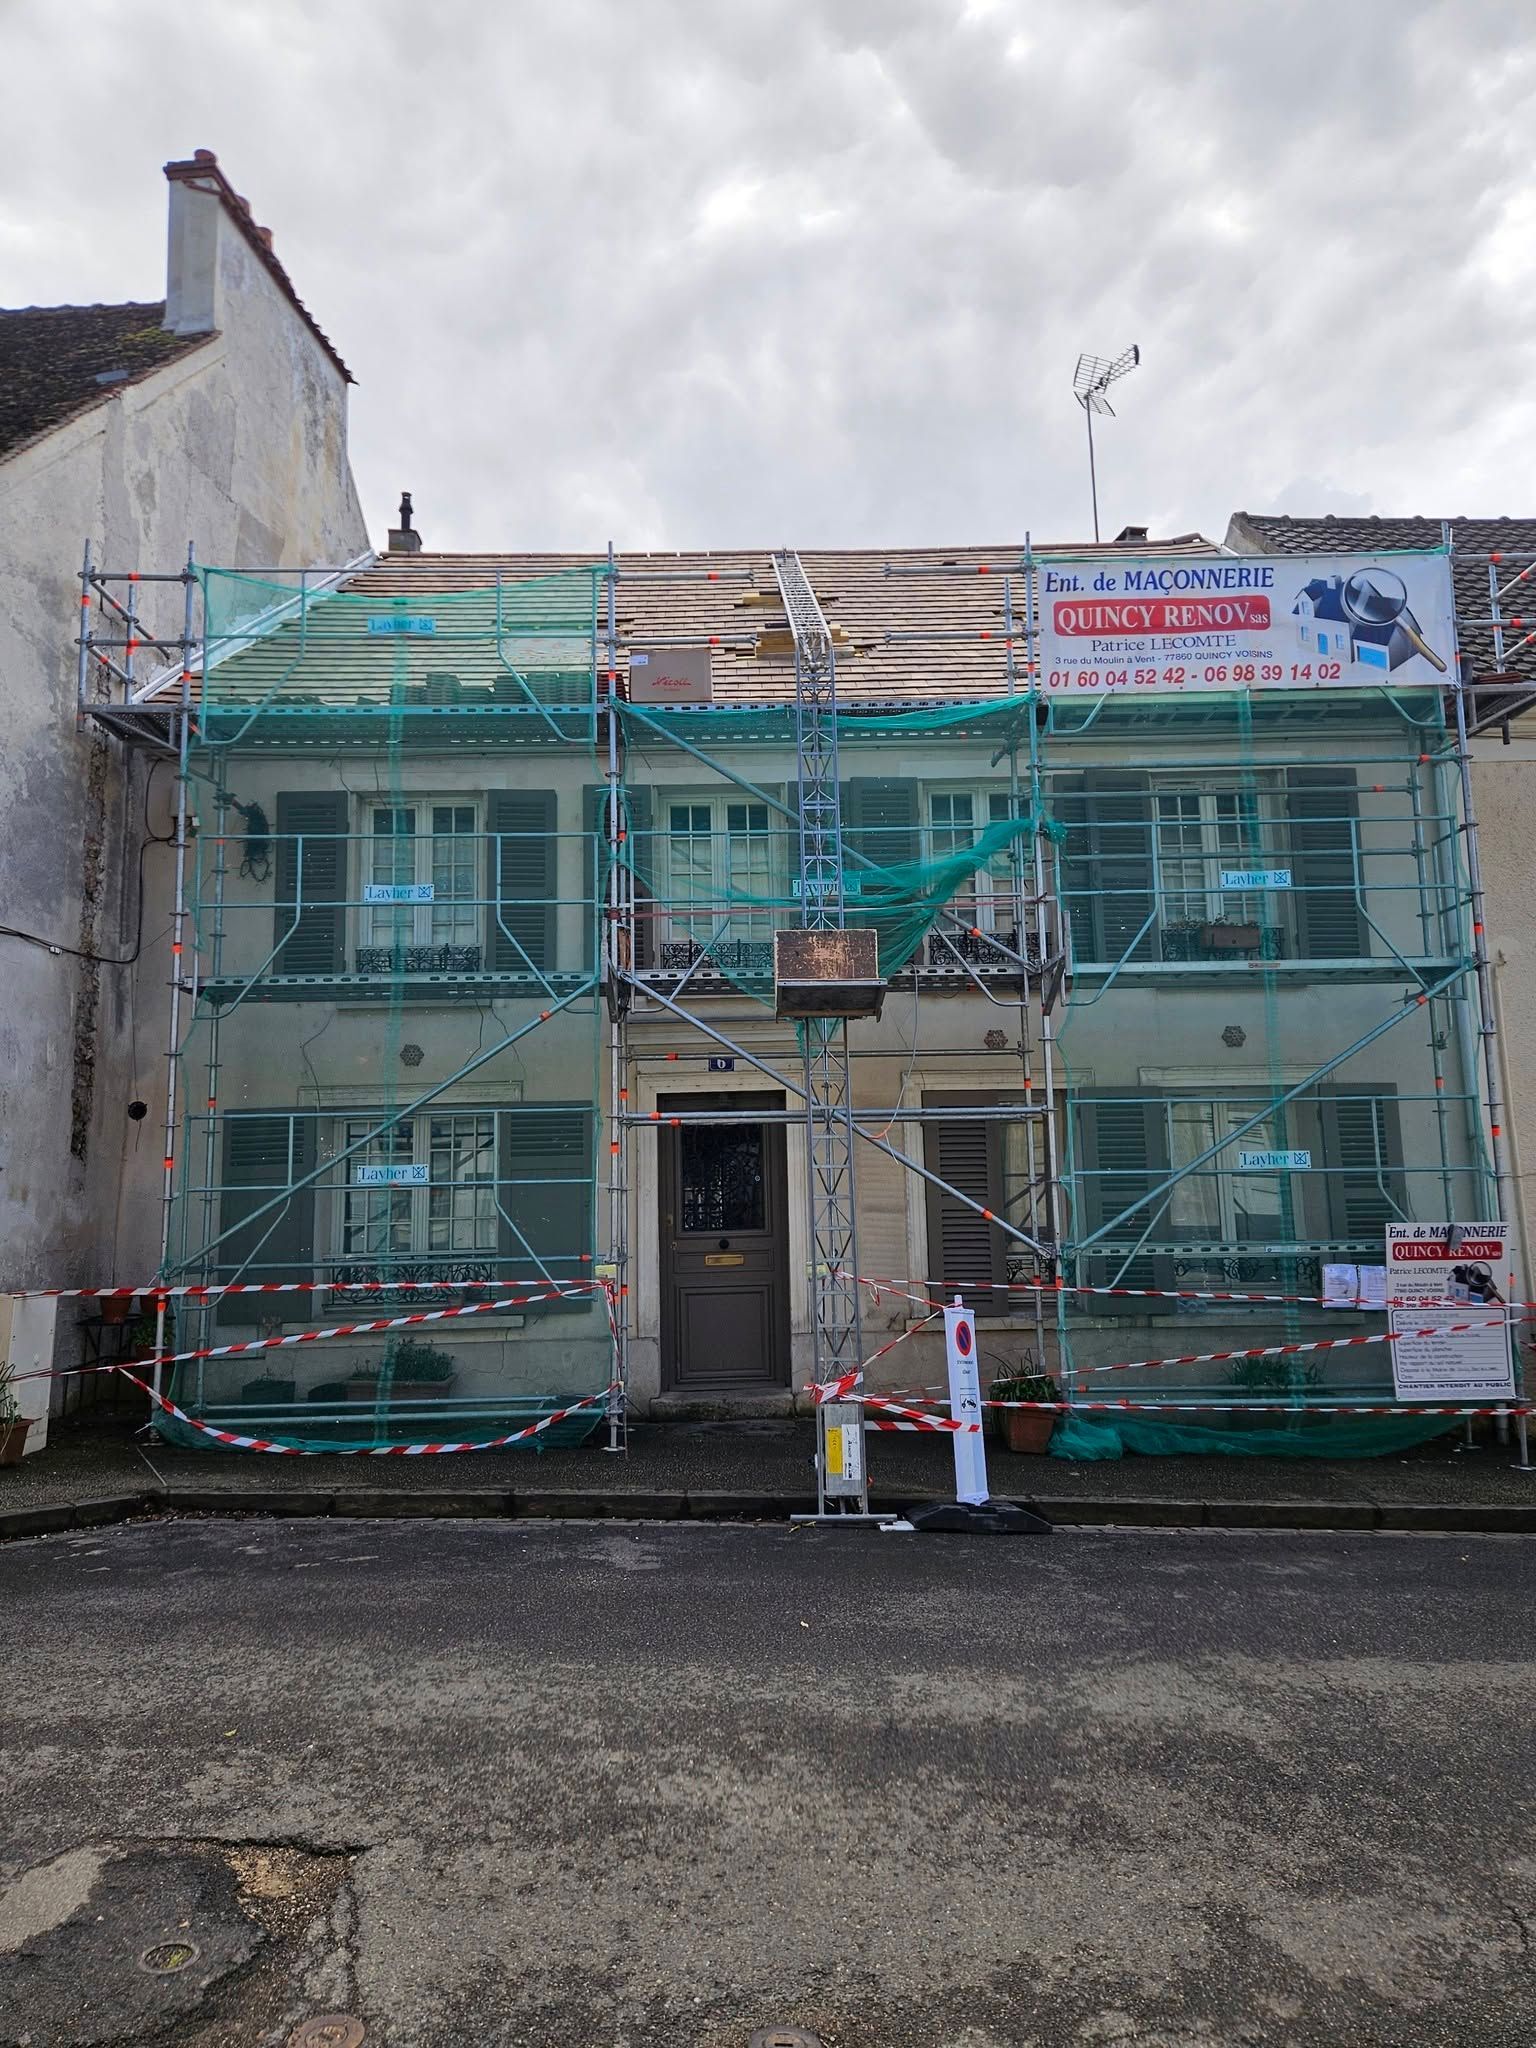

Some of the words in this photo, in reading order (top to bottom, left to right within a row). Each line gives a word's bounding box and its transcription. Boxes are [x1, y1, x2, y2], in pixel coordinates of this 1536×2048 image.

[1045, 571, 1085, 592] Ent.
[1093, 571, 1116, 591] de
[1124, 567, 1274, 595] MAÇONNERIE
[1058, 605, 1156, 634] QUINCY
[1163, 602, 1250, 627] RENOV
[1092, 639, 1145, 652] Patrice
[1151, 635, 1237, 650] LECOMTE
[1055, 657, 1062, 665] 3
[1080, 657, 1092, 665] du
[1094, 656, 1124, 665] Moulin
[1134, 655, 1155, 664] Vent
[1195, 651, 1232, 660] QUINCY
[1235, 650, 1273, 659] VOISINS
[1049, 670, 1070, 687] 01
[1077, 670, 1100, 687] 60
[1105, 670, 1128, 686] 04
[1134, 669, 1157, 685] 52
[1162, 667, 1185, 684] 42
[1204, 665, 1227, 682] 06
[1232, 664, 1255, 681] 98
[1261, 664, 1282, 681] 39
[1291, 664, 1312, 680] 14
[1318, 663, 1341, 679] 02
[1225, 872, 1268, 887] Layher
[1243, 1153, 1289, 1168] Layher
[361, 1167, 408, 1182] Layher
[1388, 1226, 1410, 1238] Ent.
[1413, 1226, 1426, 1238] de
[1429, 1225, 1508, 1238] MANNERIE
[1394, 1245, 1445, 1260] QUINCY
[1389, 1267, 1413, 1275] Patrice
[1413, 1267, 1448, 1275] LECOMTE
